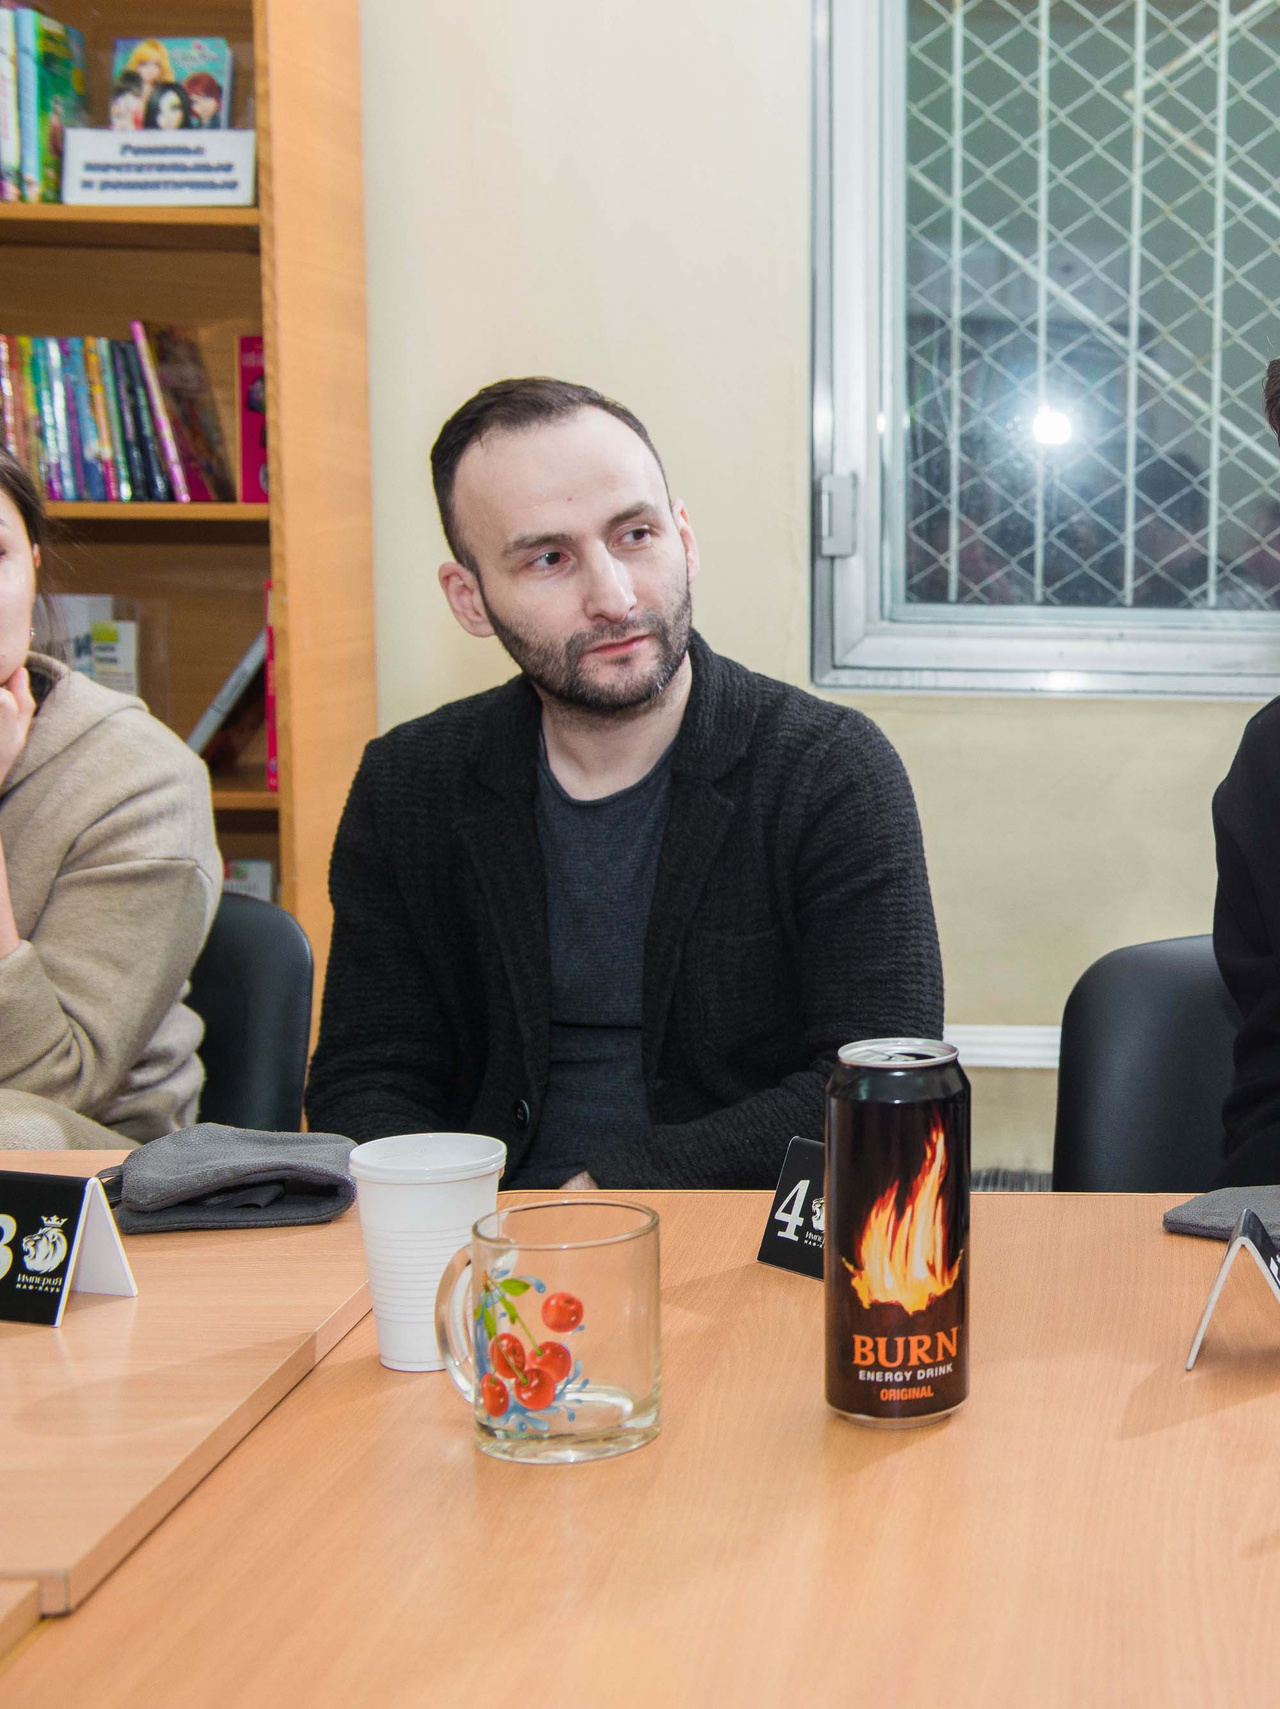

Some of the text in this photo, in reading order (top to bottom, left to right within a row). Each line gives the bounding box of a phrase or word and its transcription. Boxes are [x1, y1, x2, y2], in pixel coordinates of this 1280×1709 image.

[774, 1179, 810, 1242] 4
[852, 1326, 959, 1368] BURN
[858, 1363, 954, 1383] ENERGY DRINK
[880, 1385, 935, 1402] ORIGINAL
